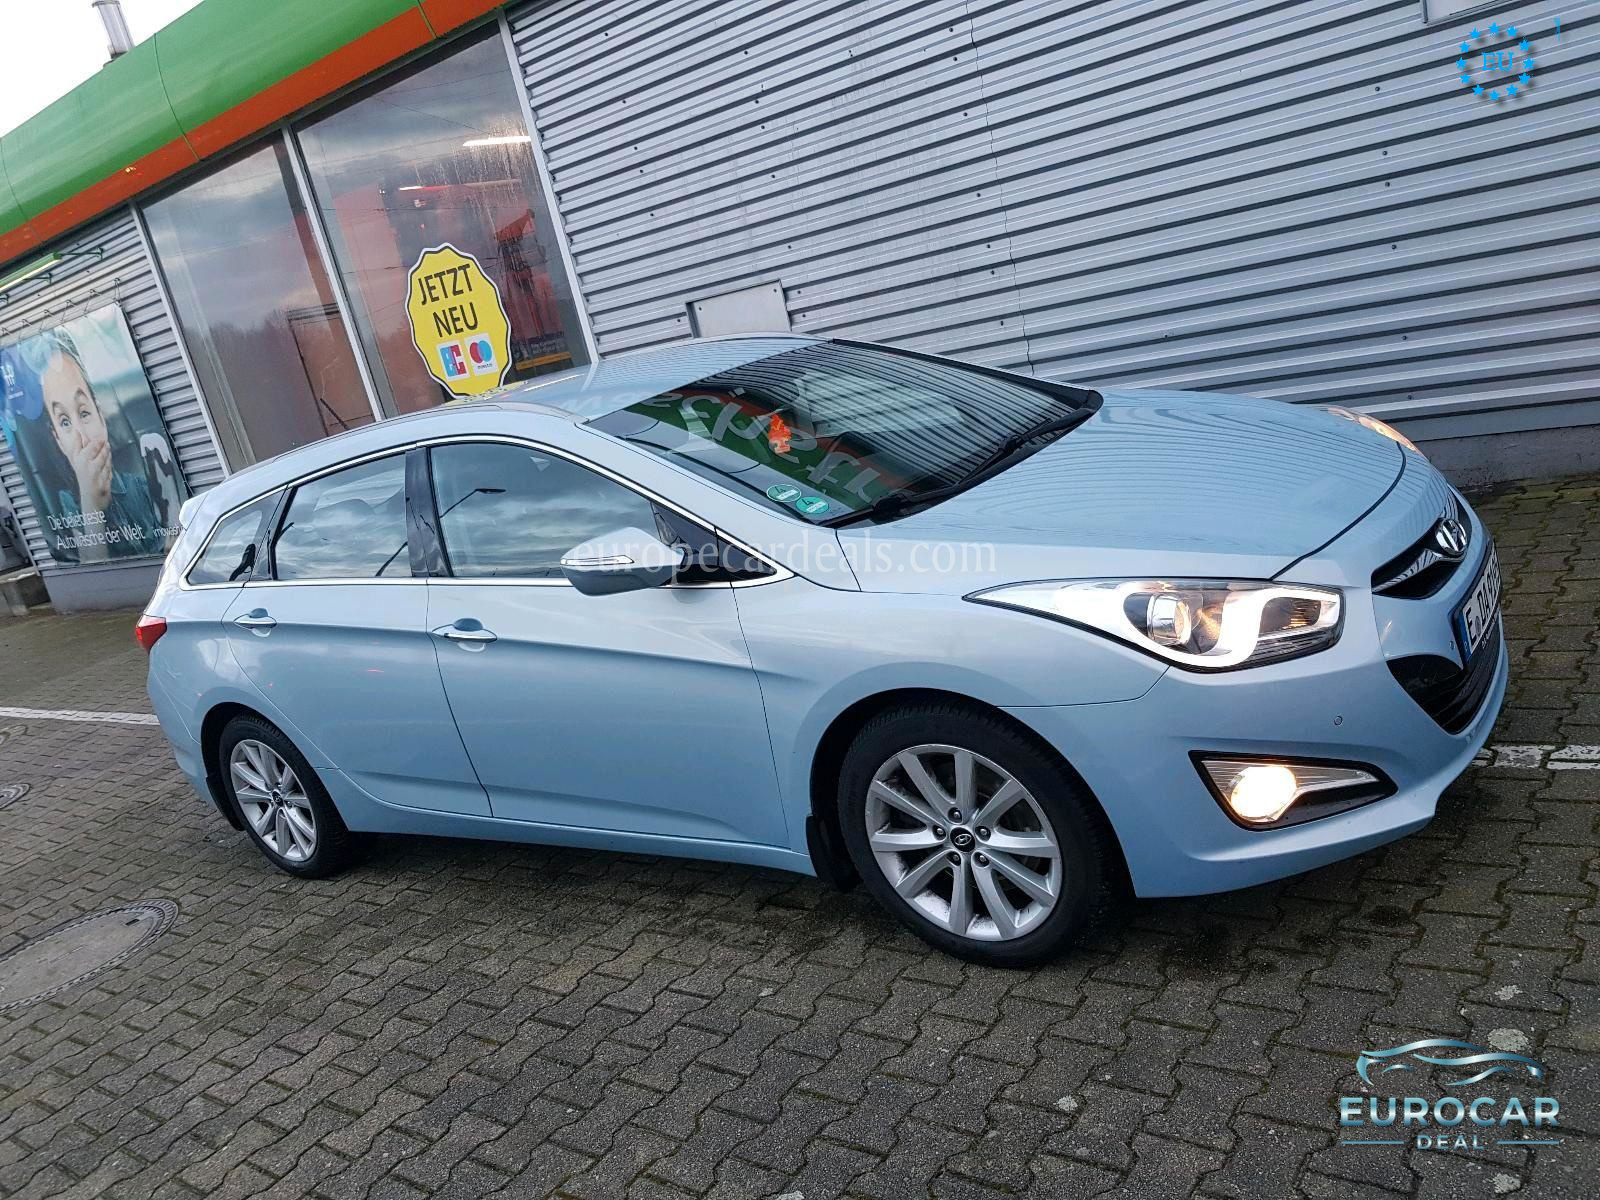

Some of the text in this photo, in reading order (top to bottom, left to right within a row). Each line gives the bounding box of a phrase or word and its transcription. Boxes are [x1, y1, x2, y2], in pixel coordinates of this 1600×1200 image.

[418, 264, 473, 306] JETZT
[433, 302, 479, 338] NEU
[440, 344, 467, 377] EC
[802, 498, 814, 506] 4
[105, 526, 121, 543] der
[119, 523, 146, 541] Welt
[1466, 607, 1477, 645] E
